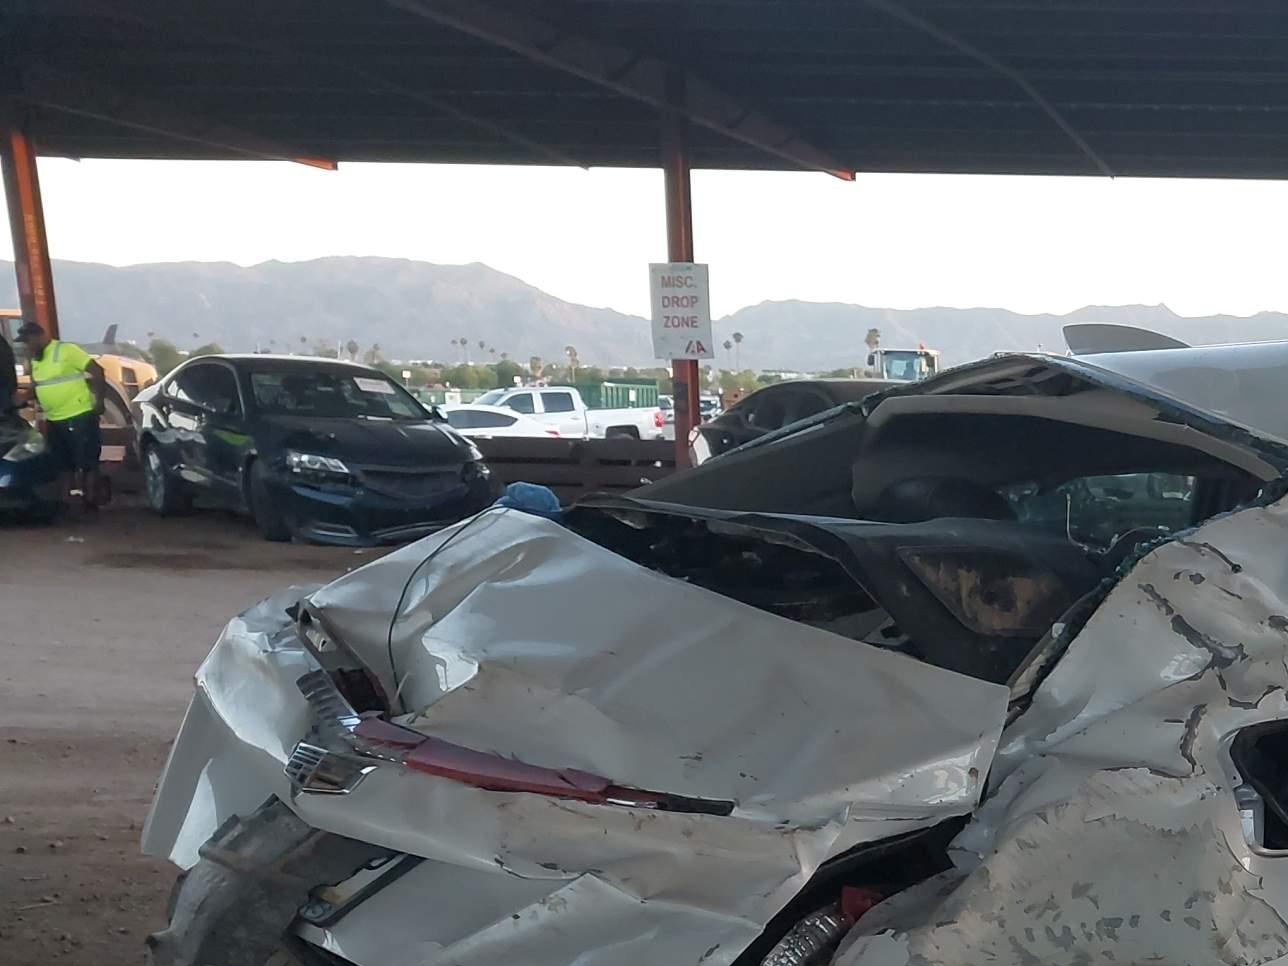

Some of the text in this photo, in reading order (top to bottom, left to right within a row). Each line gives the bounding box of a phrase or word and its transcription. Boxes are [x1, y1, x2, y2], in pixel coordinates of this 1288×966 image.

[661, 275, 697, 288] MISC.
[662, 296, 698, 308] DROP
[664, 316, 698, 328] ZONE
